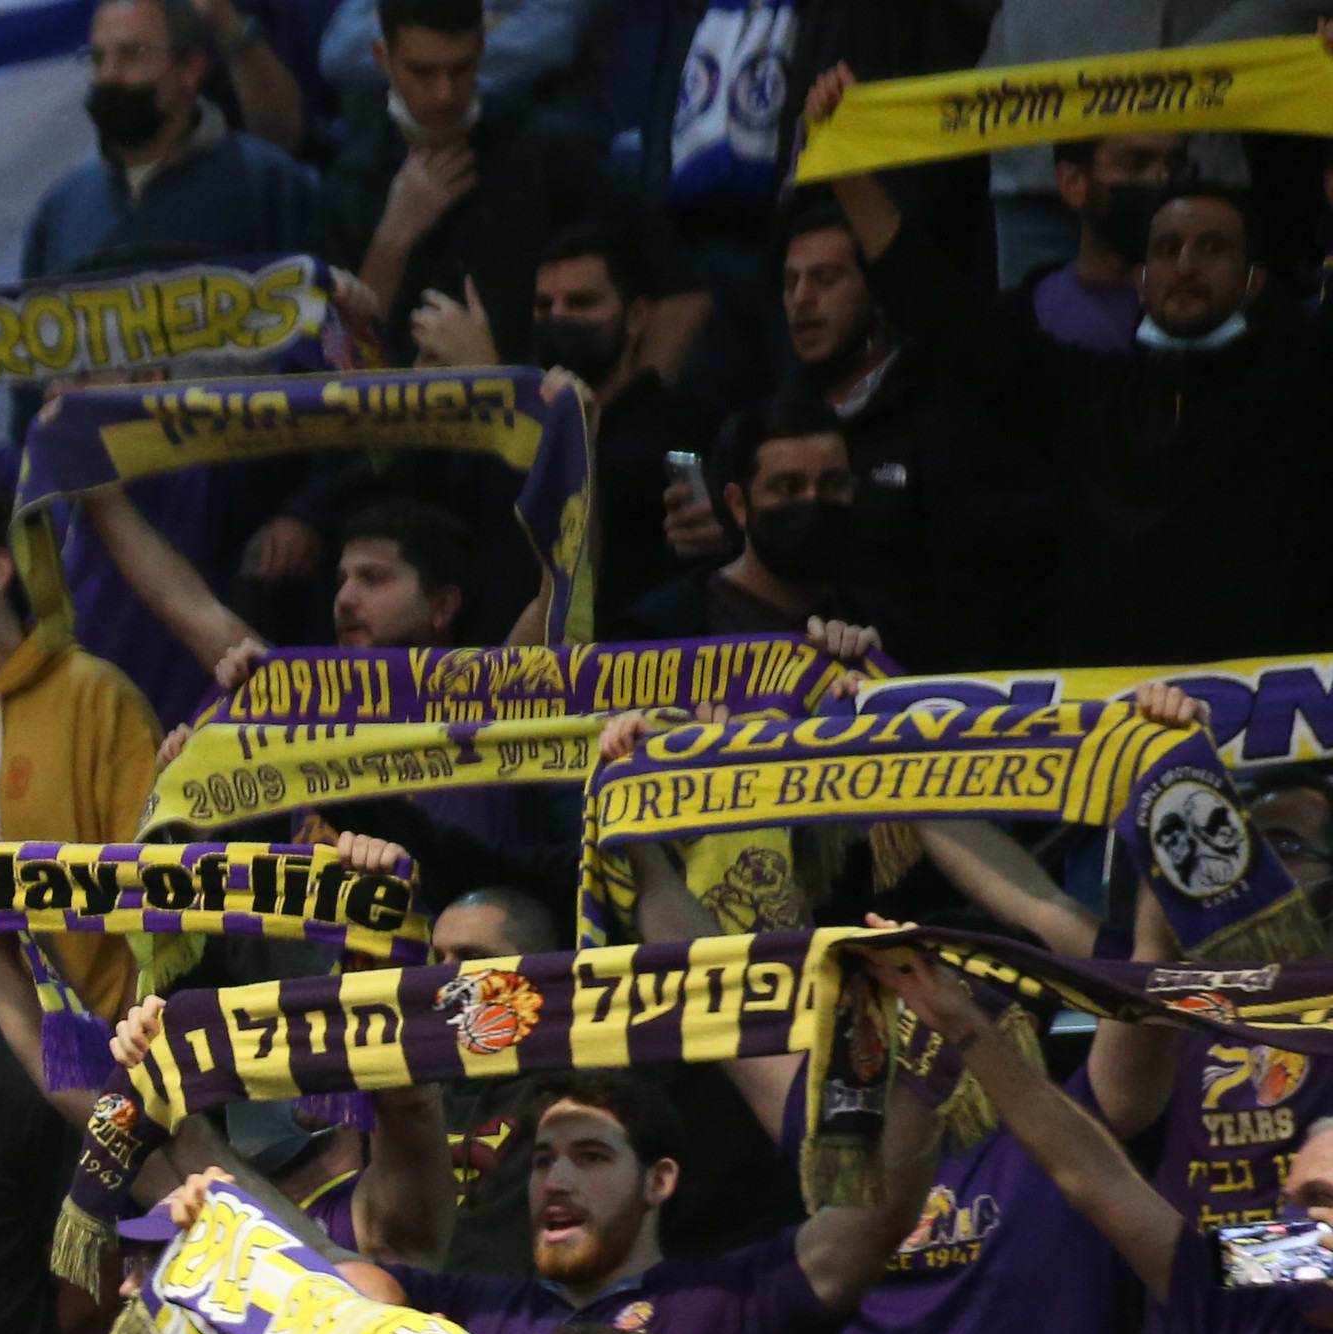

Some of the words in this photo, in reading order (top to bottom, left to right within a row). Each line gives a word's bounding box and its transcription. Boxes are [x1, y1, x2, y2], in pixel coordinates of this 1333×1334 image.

[594, 648, 683, 711] 2008
[184, 764, 286, 819] 2009
[301, 746, 453, 793] המדינה
[599, 770, 760, 827] URPLE
[776, 752, 1064, 808] BROTHERS
[139, 853, 229, 910] of
[581, 945, 819, 1027] פועל
[1202, 1107, 1296, 1147] YEARS
[924, 1241, 982, 1269] 1947
